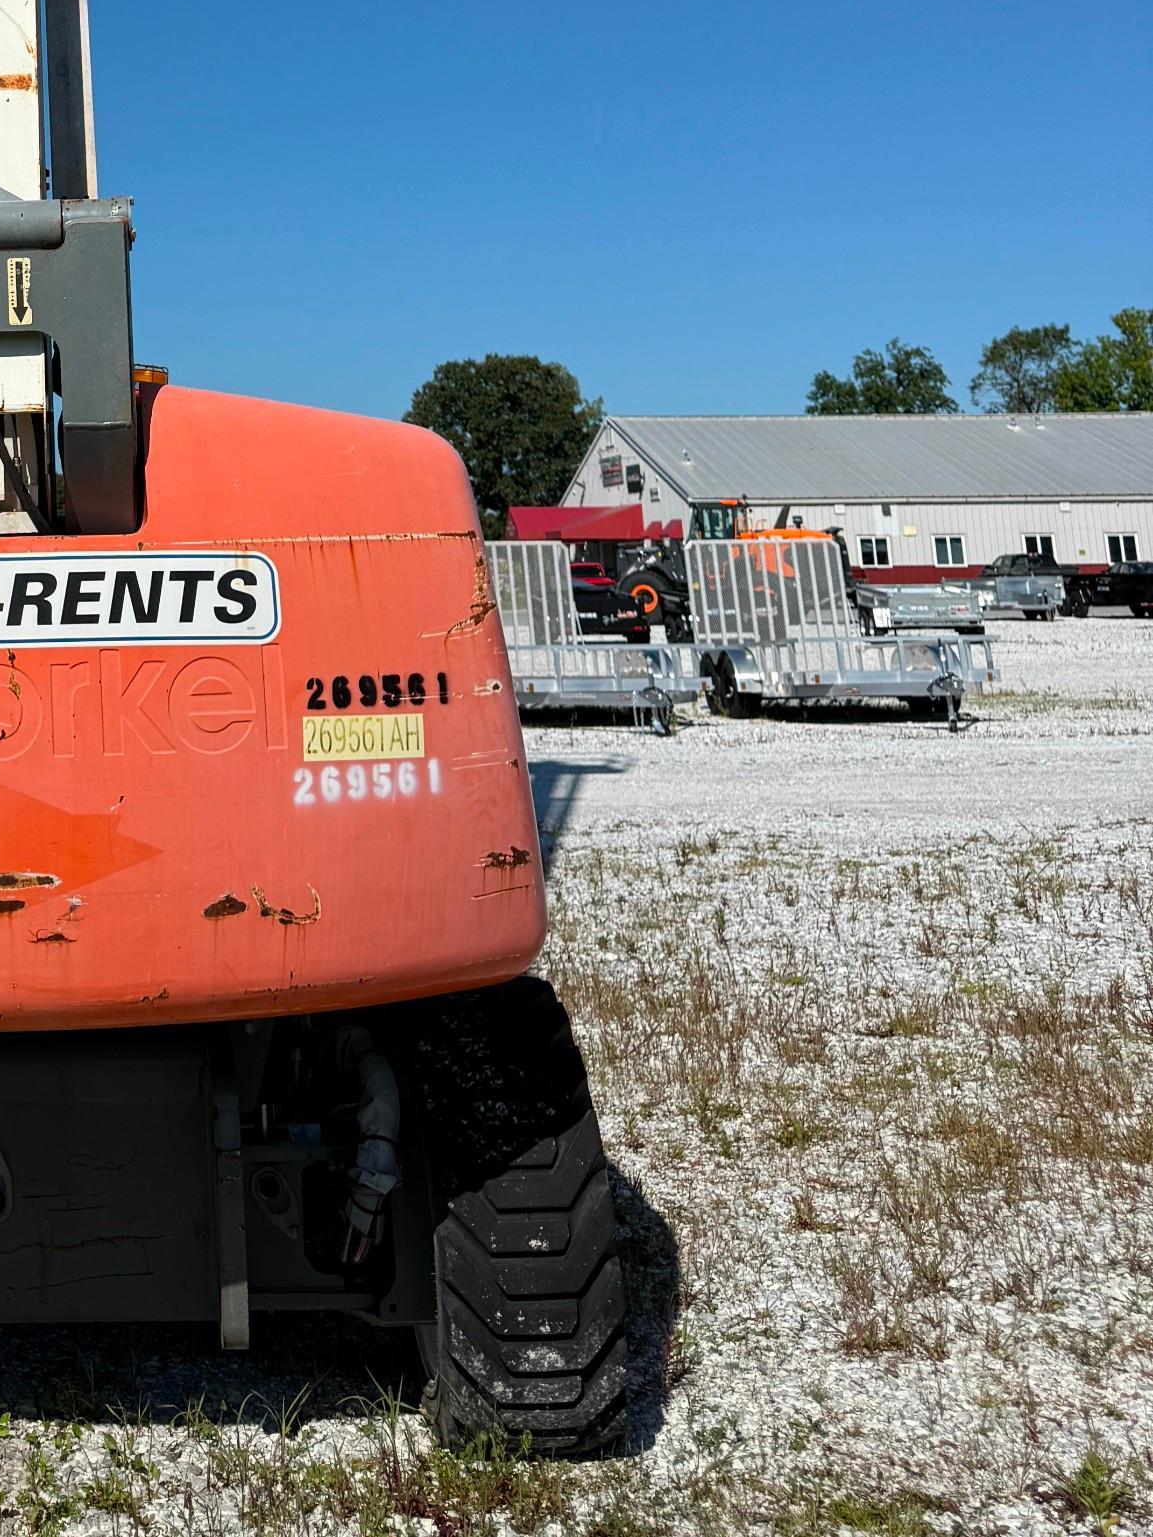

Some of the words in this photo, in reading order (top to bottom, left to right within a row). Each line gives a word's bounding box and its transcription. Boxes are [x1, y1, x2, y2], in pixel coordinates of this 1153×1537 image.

[306, 672, 449, 710] 269561
[304, 715, 421, 754] 269561AH
[293, 757, 443, 806] 269561
